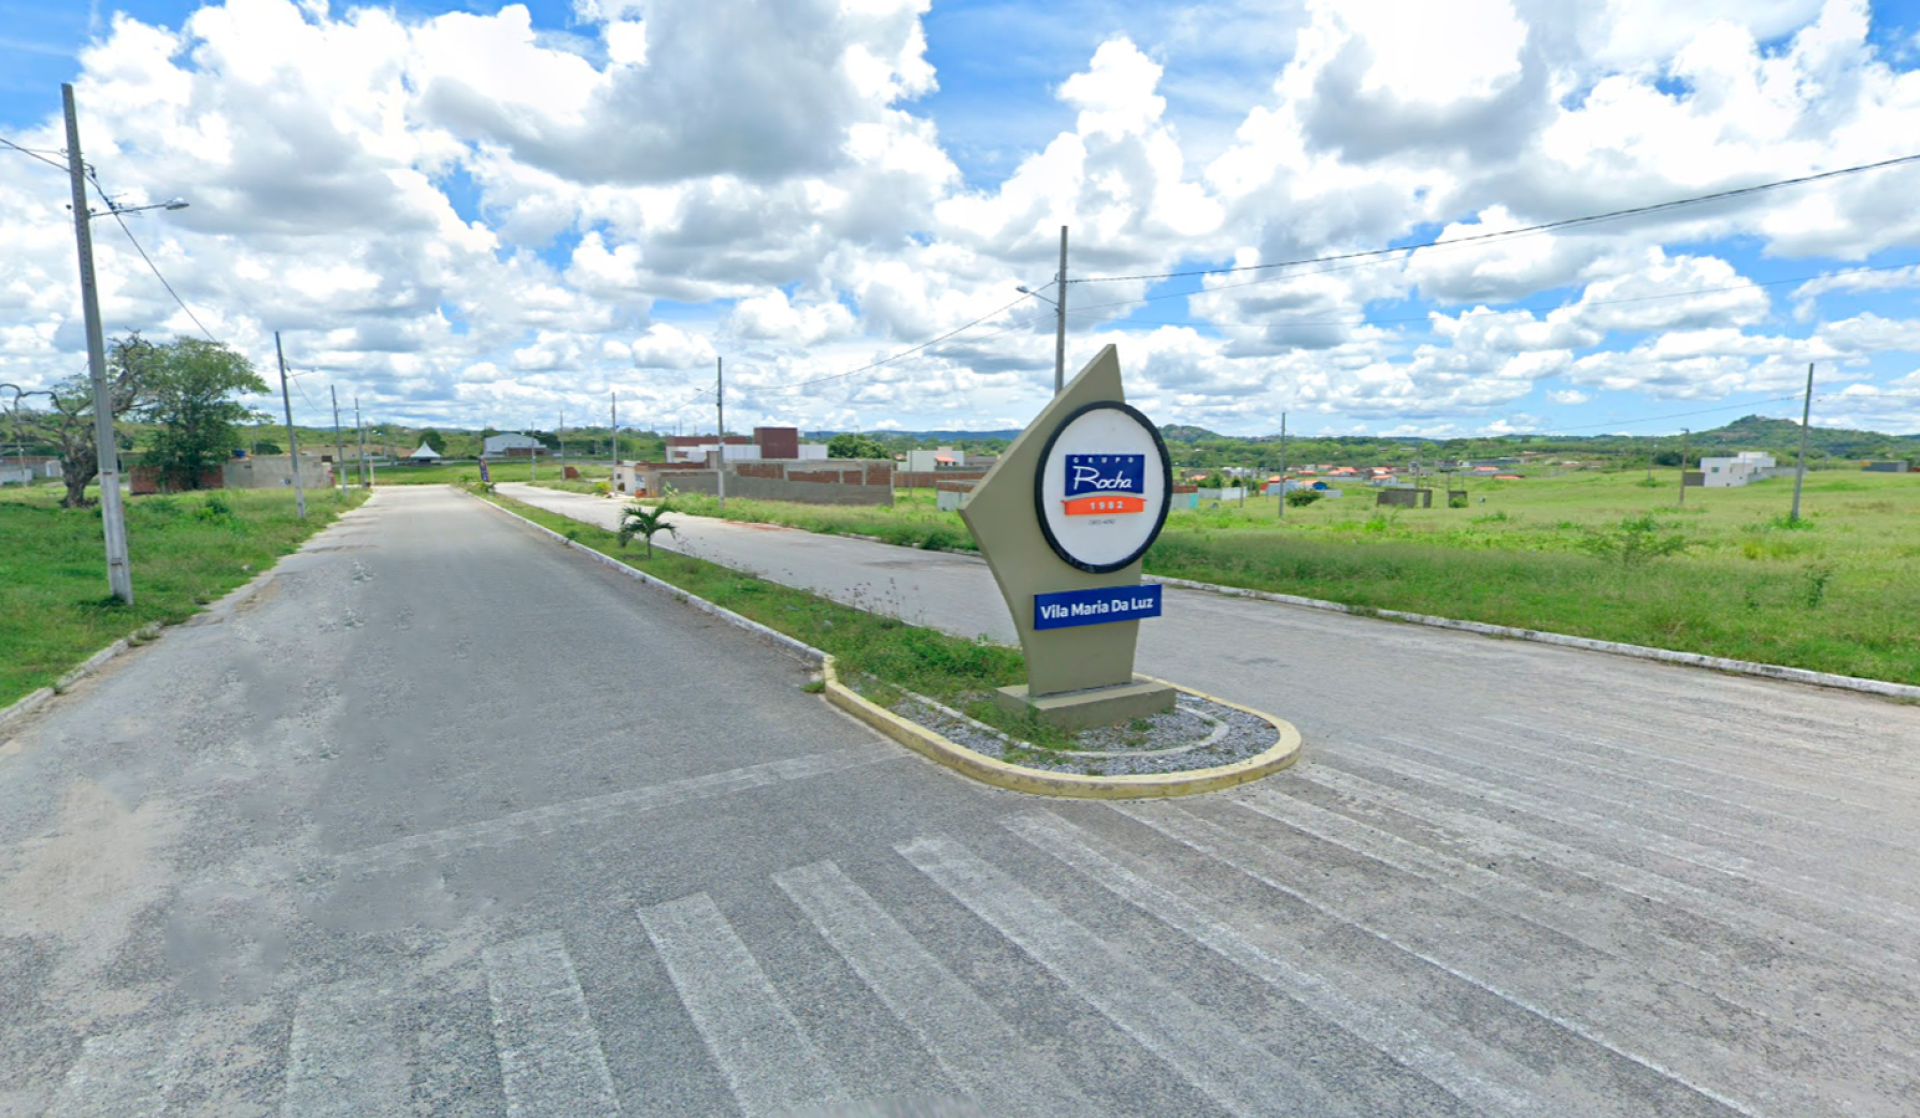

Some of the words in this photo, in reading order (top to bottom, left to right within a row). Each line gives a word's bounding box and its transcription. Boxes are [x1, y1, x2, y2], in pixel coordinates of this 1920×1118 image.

[1072, 465, 1133, 490] Rocha
[1040, 604, 1069, 619] Vila
[1071, 600, 1109, 616] Maria
[1111, 599, 1129, 612] Da
[1131, 597, 1154, 610] Luz
